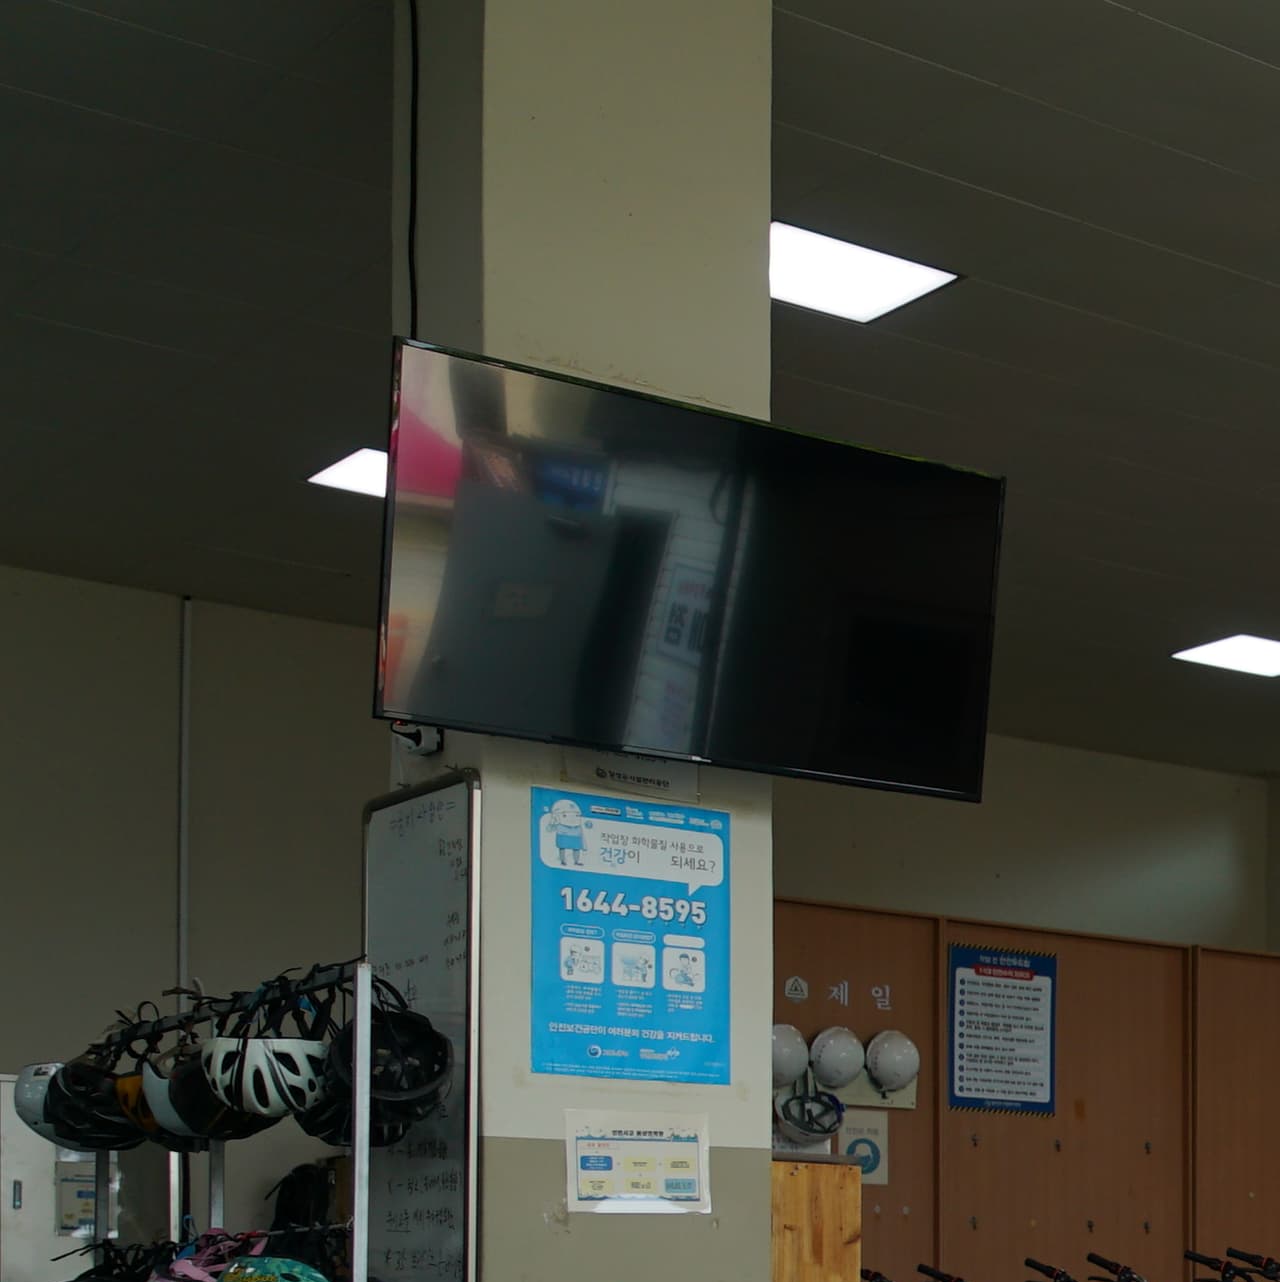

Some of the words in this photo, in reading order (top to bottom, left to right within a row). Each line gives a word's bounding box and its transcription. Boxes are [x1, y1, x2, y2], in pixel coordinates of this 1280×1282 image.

[601, 832, 629, 847] 작업장
[631, 836, 668, 851] 화학물질
[671, 841, 704, 855] 사용으로
[600, 847, 640, 865] 건강이
[671, 855, 717, 873] 되세요?
[560, 886, 707, 925] 1644-8595
